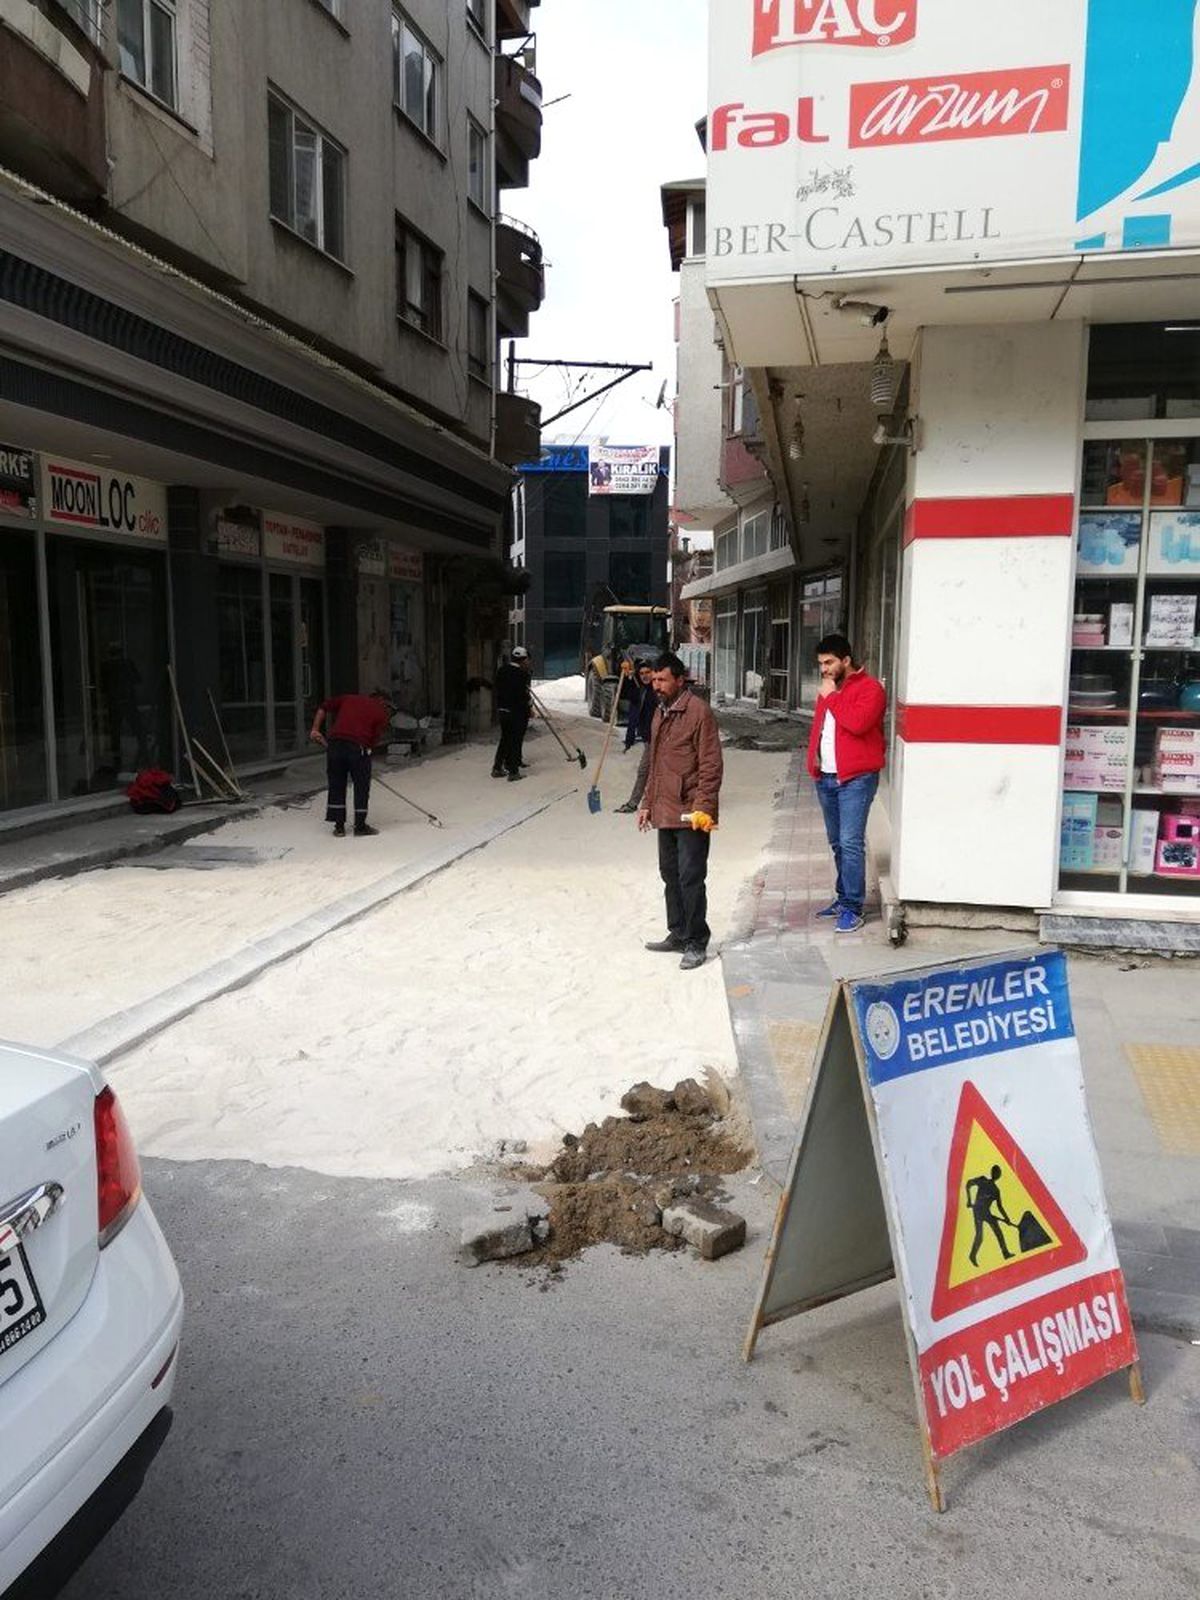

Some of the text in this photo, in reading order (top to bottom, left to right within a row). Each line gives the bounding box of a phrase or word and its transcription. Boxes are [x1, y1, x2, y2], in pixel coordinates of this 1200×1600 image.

[860, 83, 1047, 141] arzum
[611, 463, 657, 475] KIRALIK
[903, 966, 1048, 1022] ERENLER
[907, 999, 1056, 1062] BELEDİYESİ
[931, 1292, 1123, 1417] YOL ÇALIŞMASI
